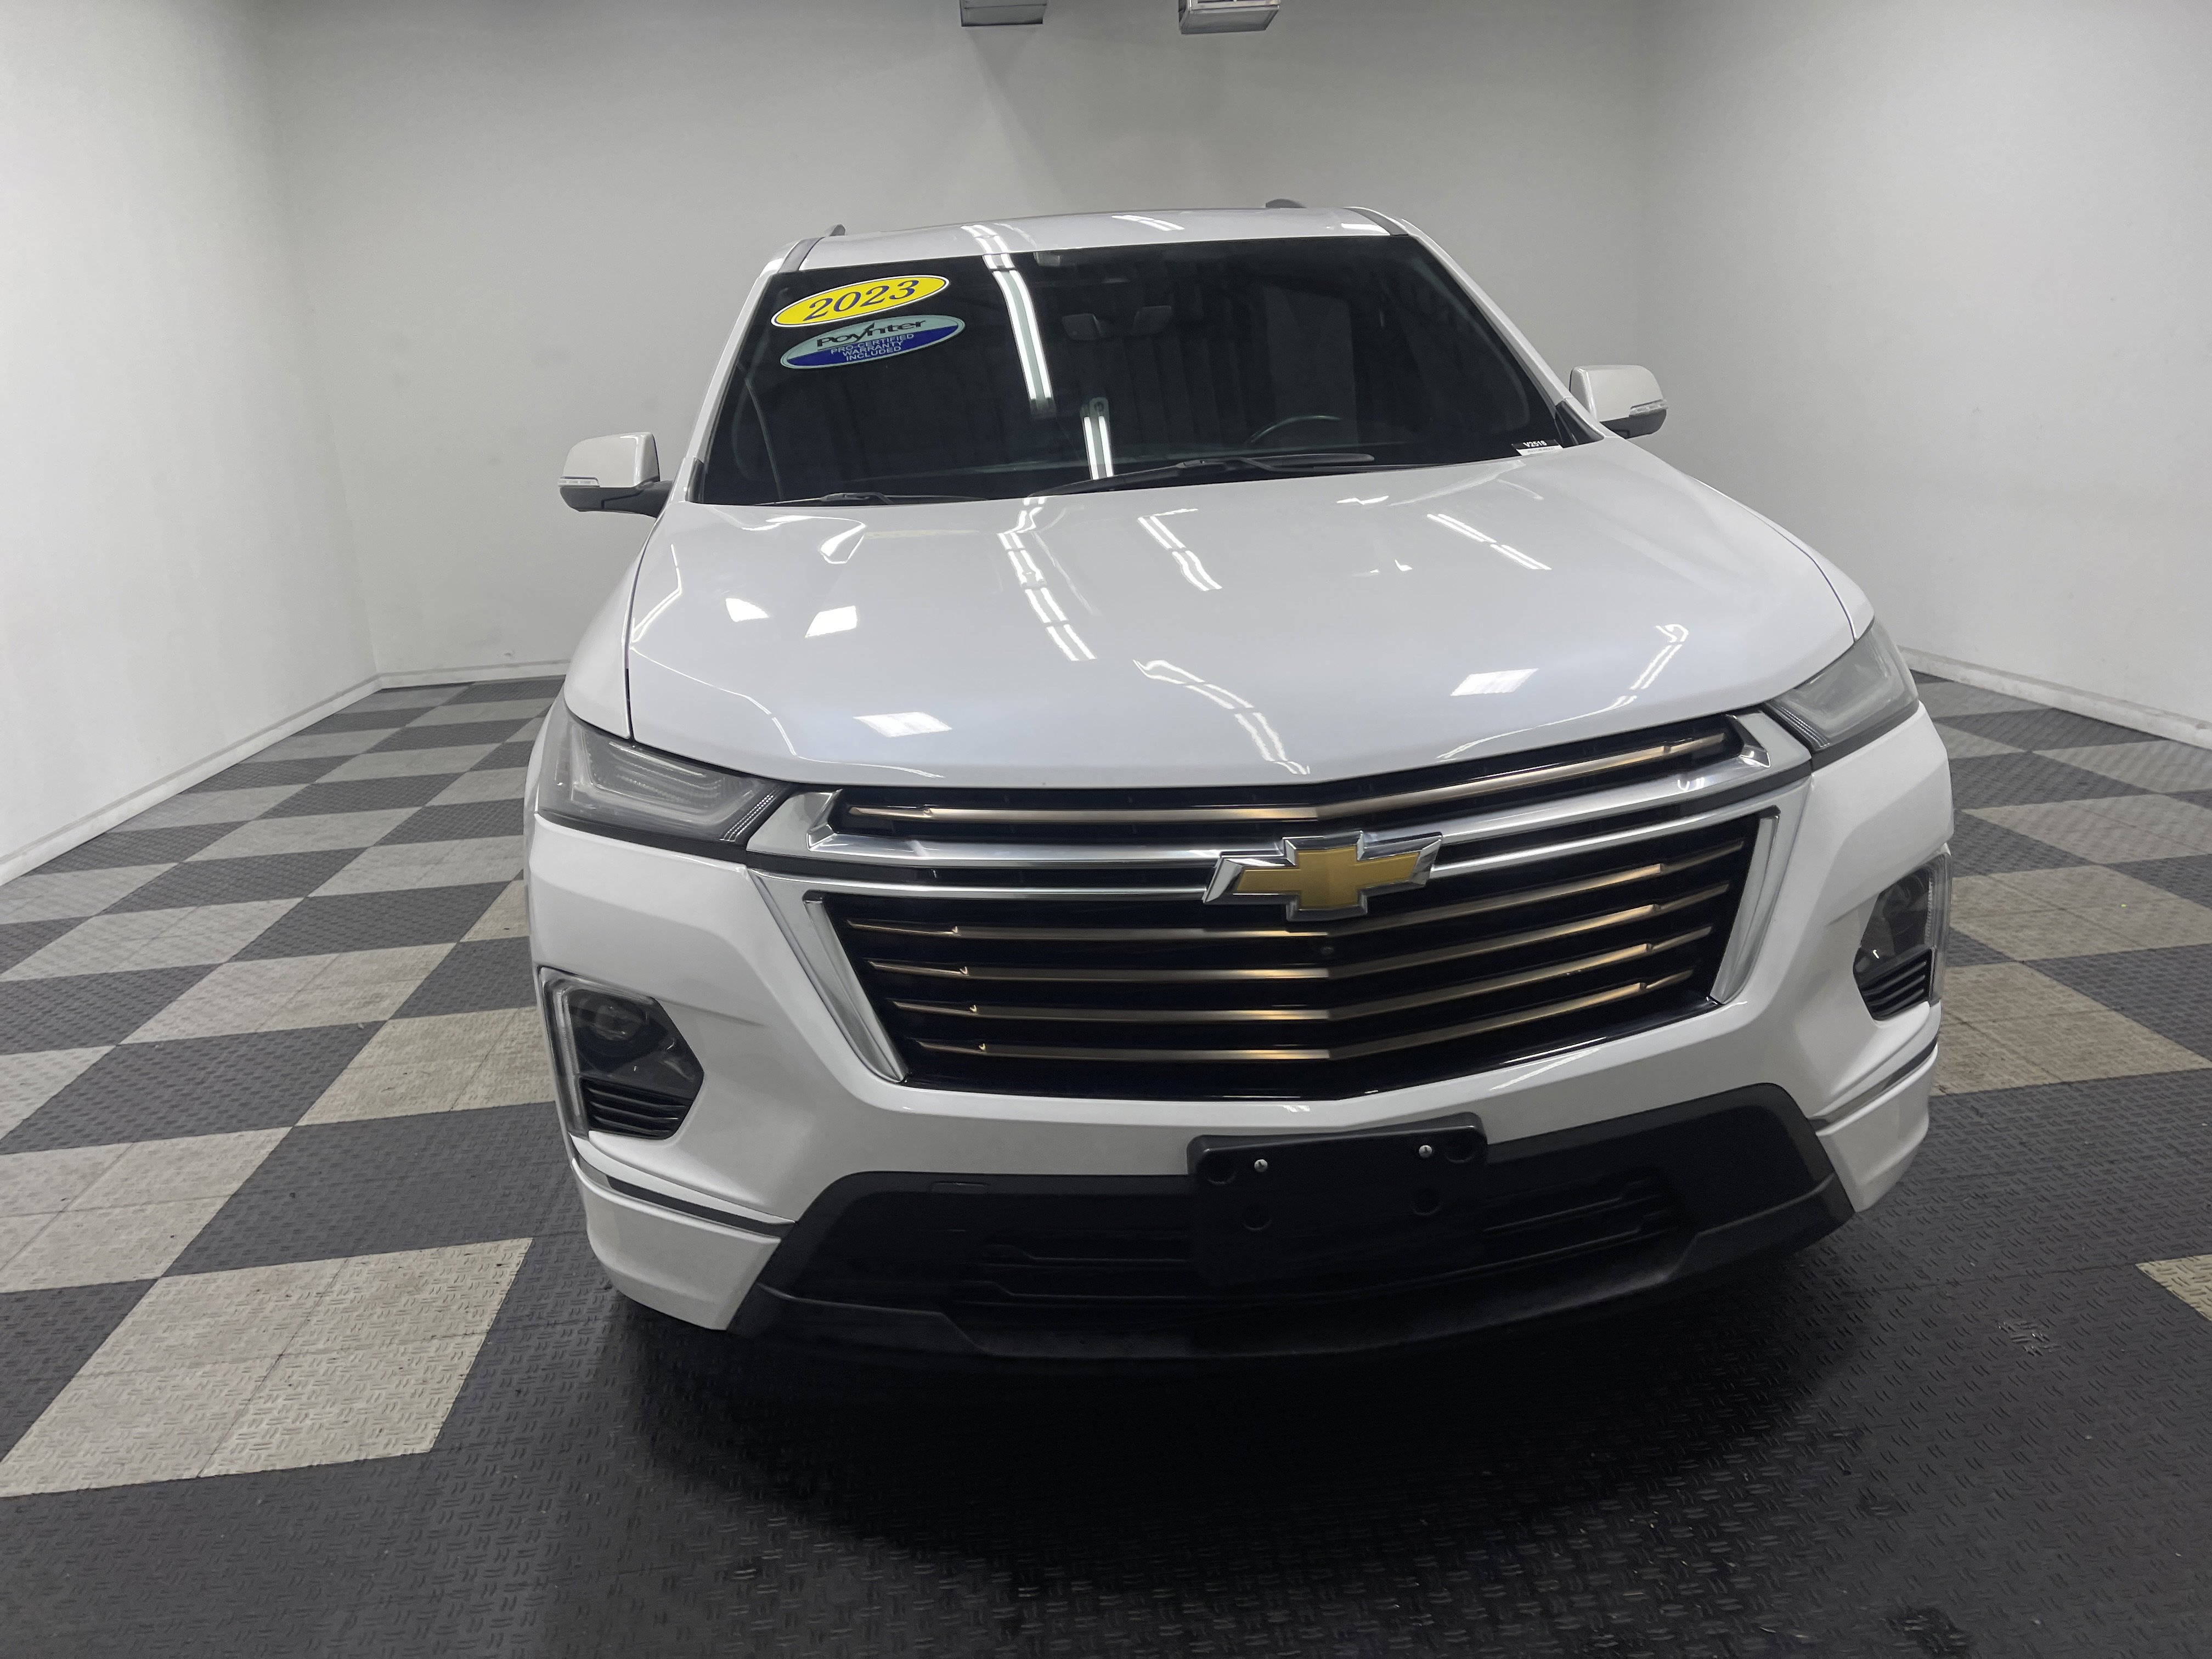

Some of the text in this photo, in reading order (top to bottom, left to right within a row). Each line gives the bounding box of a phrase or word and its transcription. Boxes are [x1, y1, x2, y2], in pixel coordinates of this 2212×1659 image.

[803, 280, 919, 321] 2023
[842, 340, 904, 356] WARRANTY
[846, 346, 901, 362] INCLUDED
